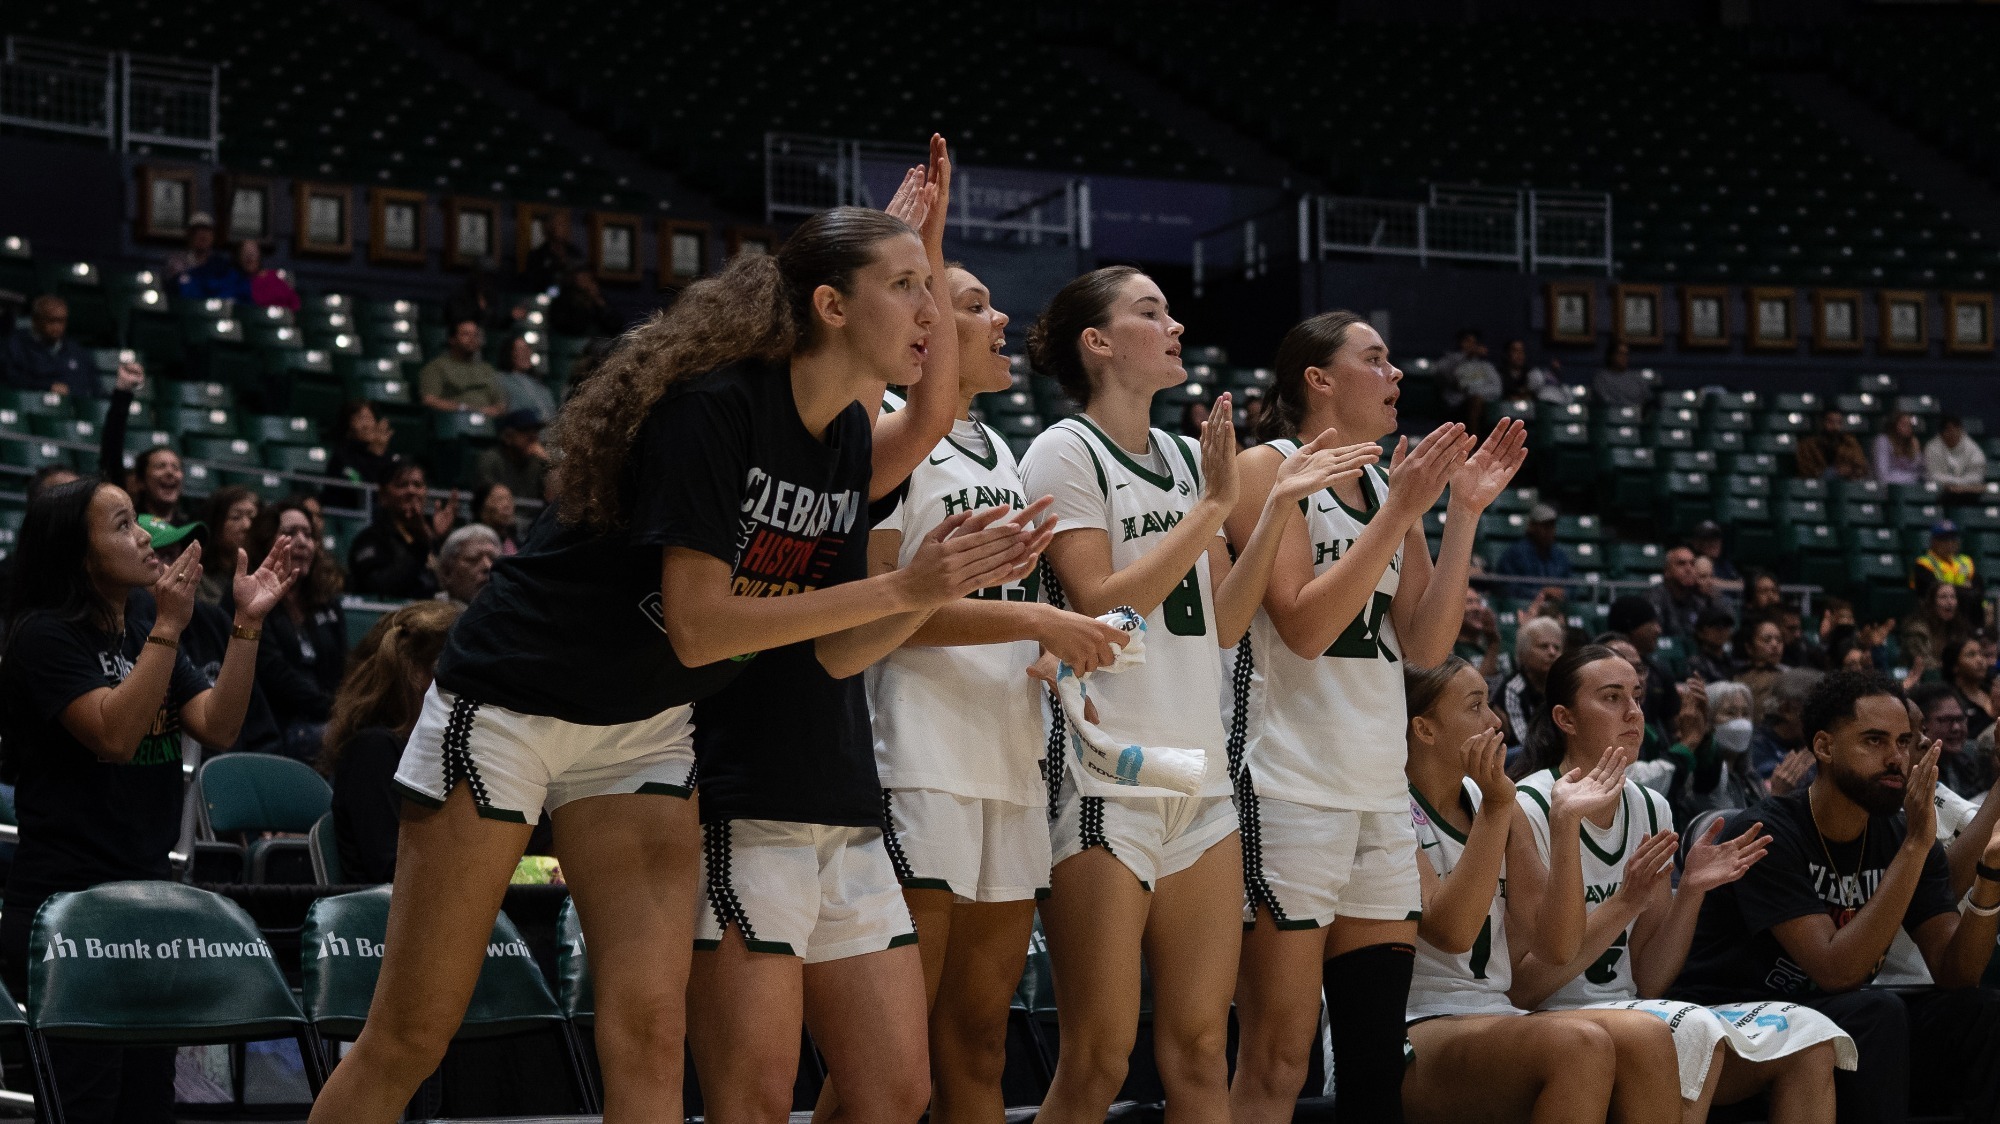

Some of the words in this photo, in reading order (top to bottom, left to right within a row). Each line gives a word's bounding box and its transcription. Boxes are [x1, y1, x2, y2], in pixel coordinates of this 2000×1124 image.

[1121, 510, 1186, 543] HAW
[84, 938, 151, 959] Bank
[156, 938, 182, 959] of
[187, 937, 272, 959] Hawaii
[355, 938, 386, 958] Ba
[486, 938, 532, 958] waii
